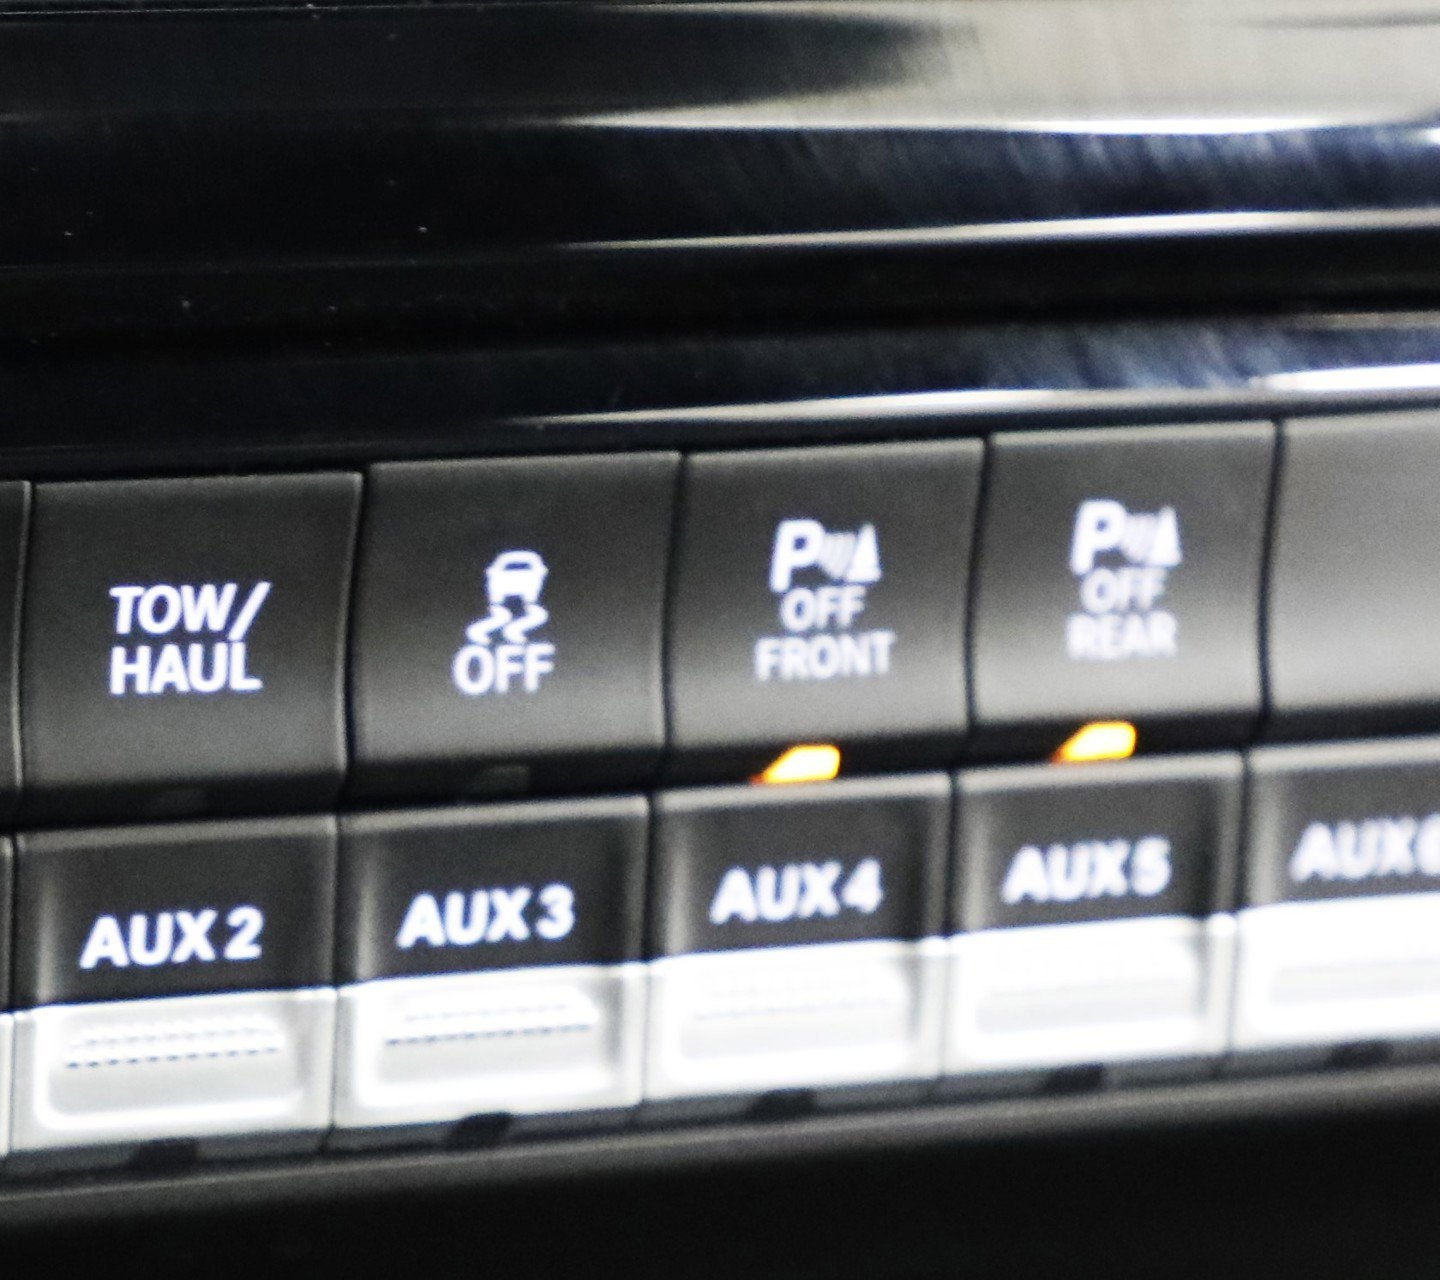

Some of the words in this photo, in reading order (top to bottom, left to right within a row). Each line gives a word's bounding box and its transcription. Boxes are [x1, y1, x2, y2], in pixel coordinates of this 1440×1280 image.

[108, 580, 273, 643] TOW/
[778, 585, 866, 632] OFF
[1077, 567, 1170, 616] OFF
[754, 629, 897, 681] FRONT
[1064, 610, 1180, 662] REAR
[108, 640, 265, 696] HAUL
[450, 643, 557, 697] OFF
